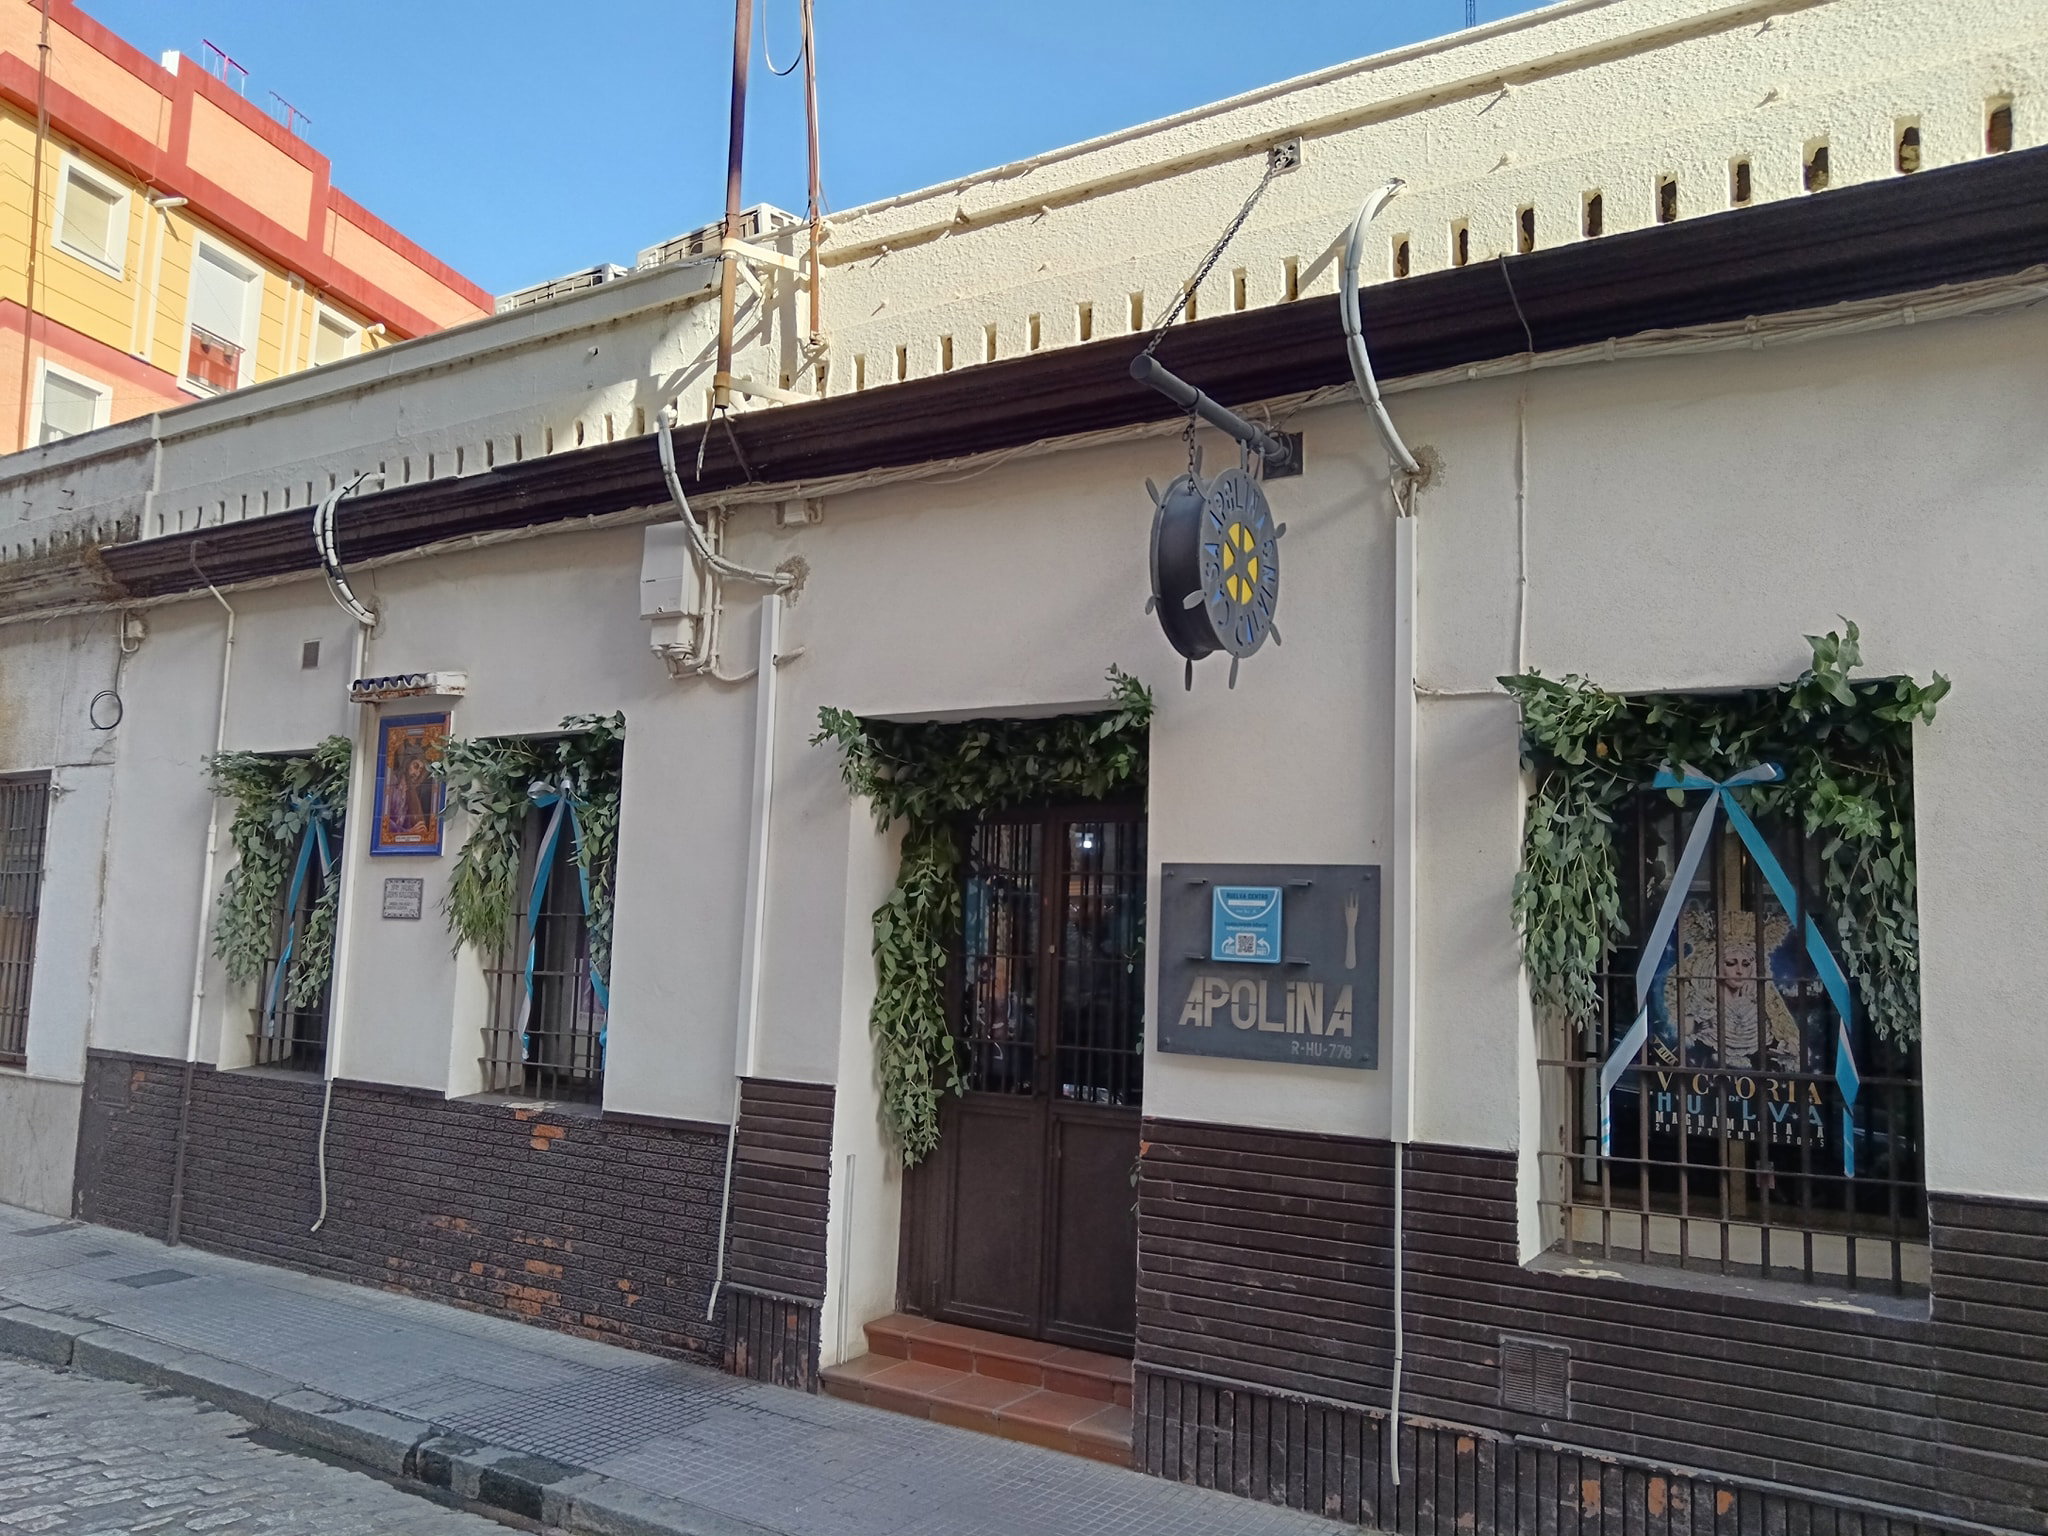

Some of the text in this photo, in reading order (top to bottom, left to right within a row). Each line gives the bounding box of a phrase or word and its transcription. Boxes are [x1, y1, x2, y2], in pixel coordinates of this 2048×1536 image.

[1291, 1040, 1352, 1059] R-HU-778
[1656, 1071, 1823, 1105] VCORIA
[1657, 1092, 1824, 1127] HULVA
[1655, 1110, 1824, 1138] MAGNA MAIAA
[1682, 1126, 1778, 1143] EPTEMBE
